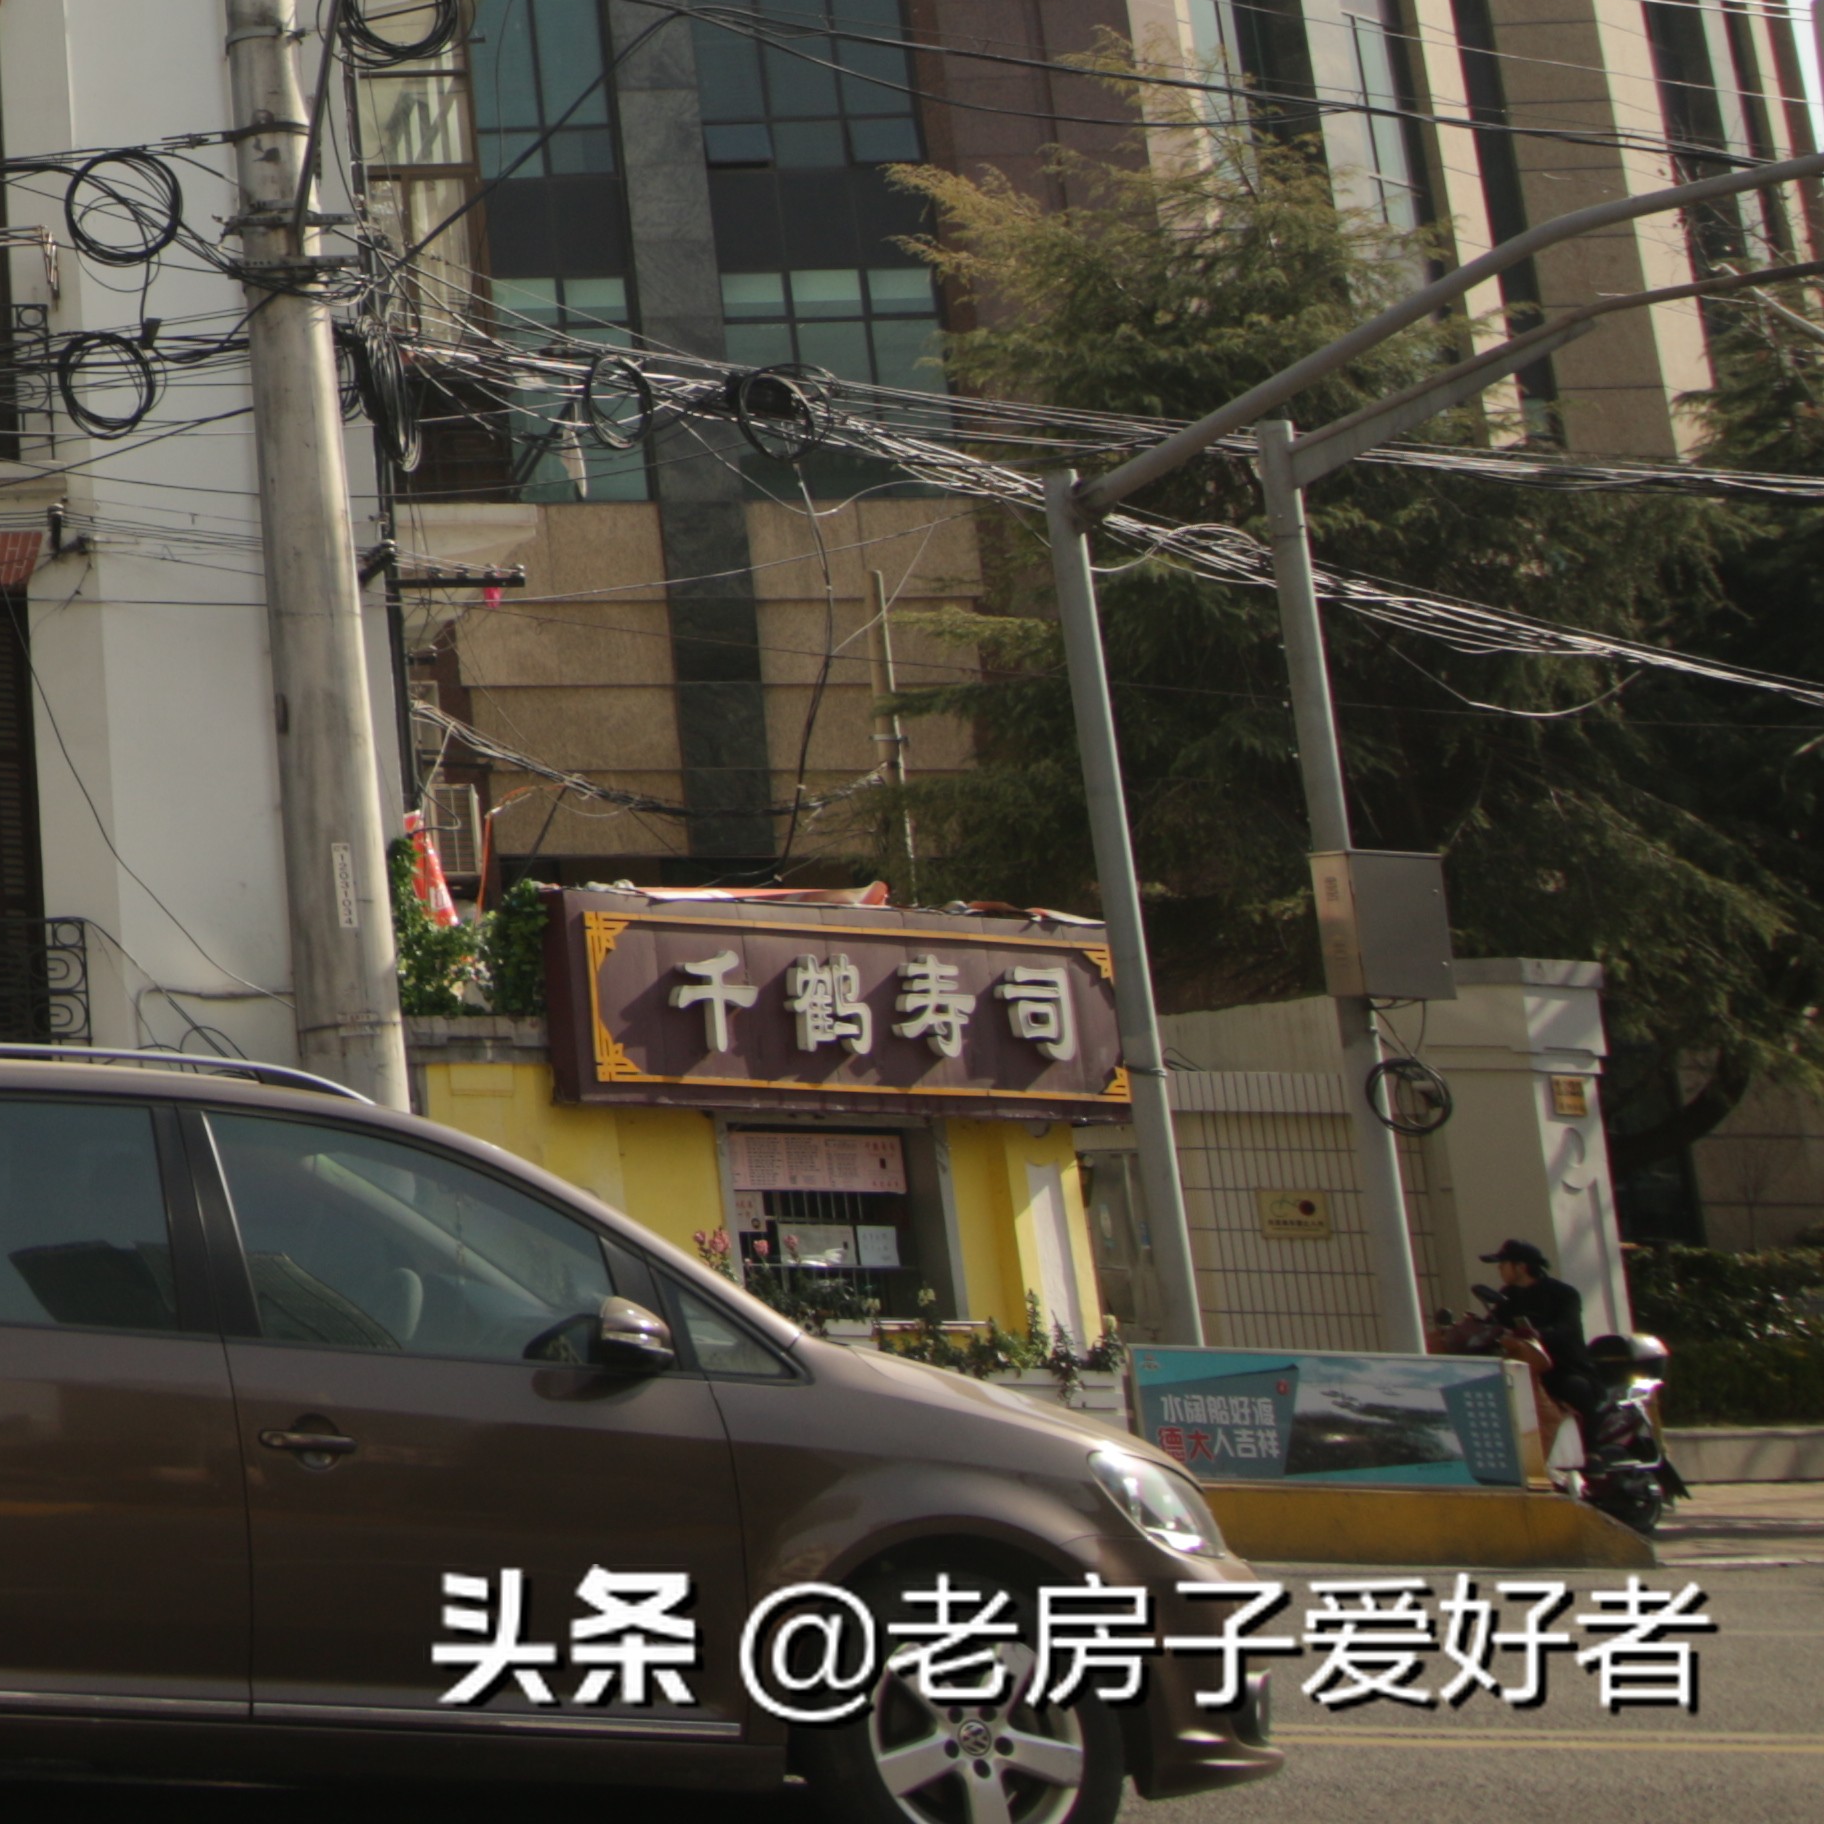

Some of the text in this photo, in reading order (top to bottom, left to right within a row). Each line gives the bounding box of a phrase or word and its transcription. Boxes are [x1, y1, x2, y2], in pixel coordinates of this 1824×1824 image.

[667, 949, 1078, 1062] 千鹤寿司
[1160, 1393, 1276, 1426] 水阔船好渡
